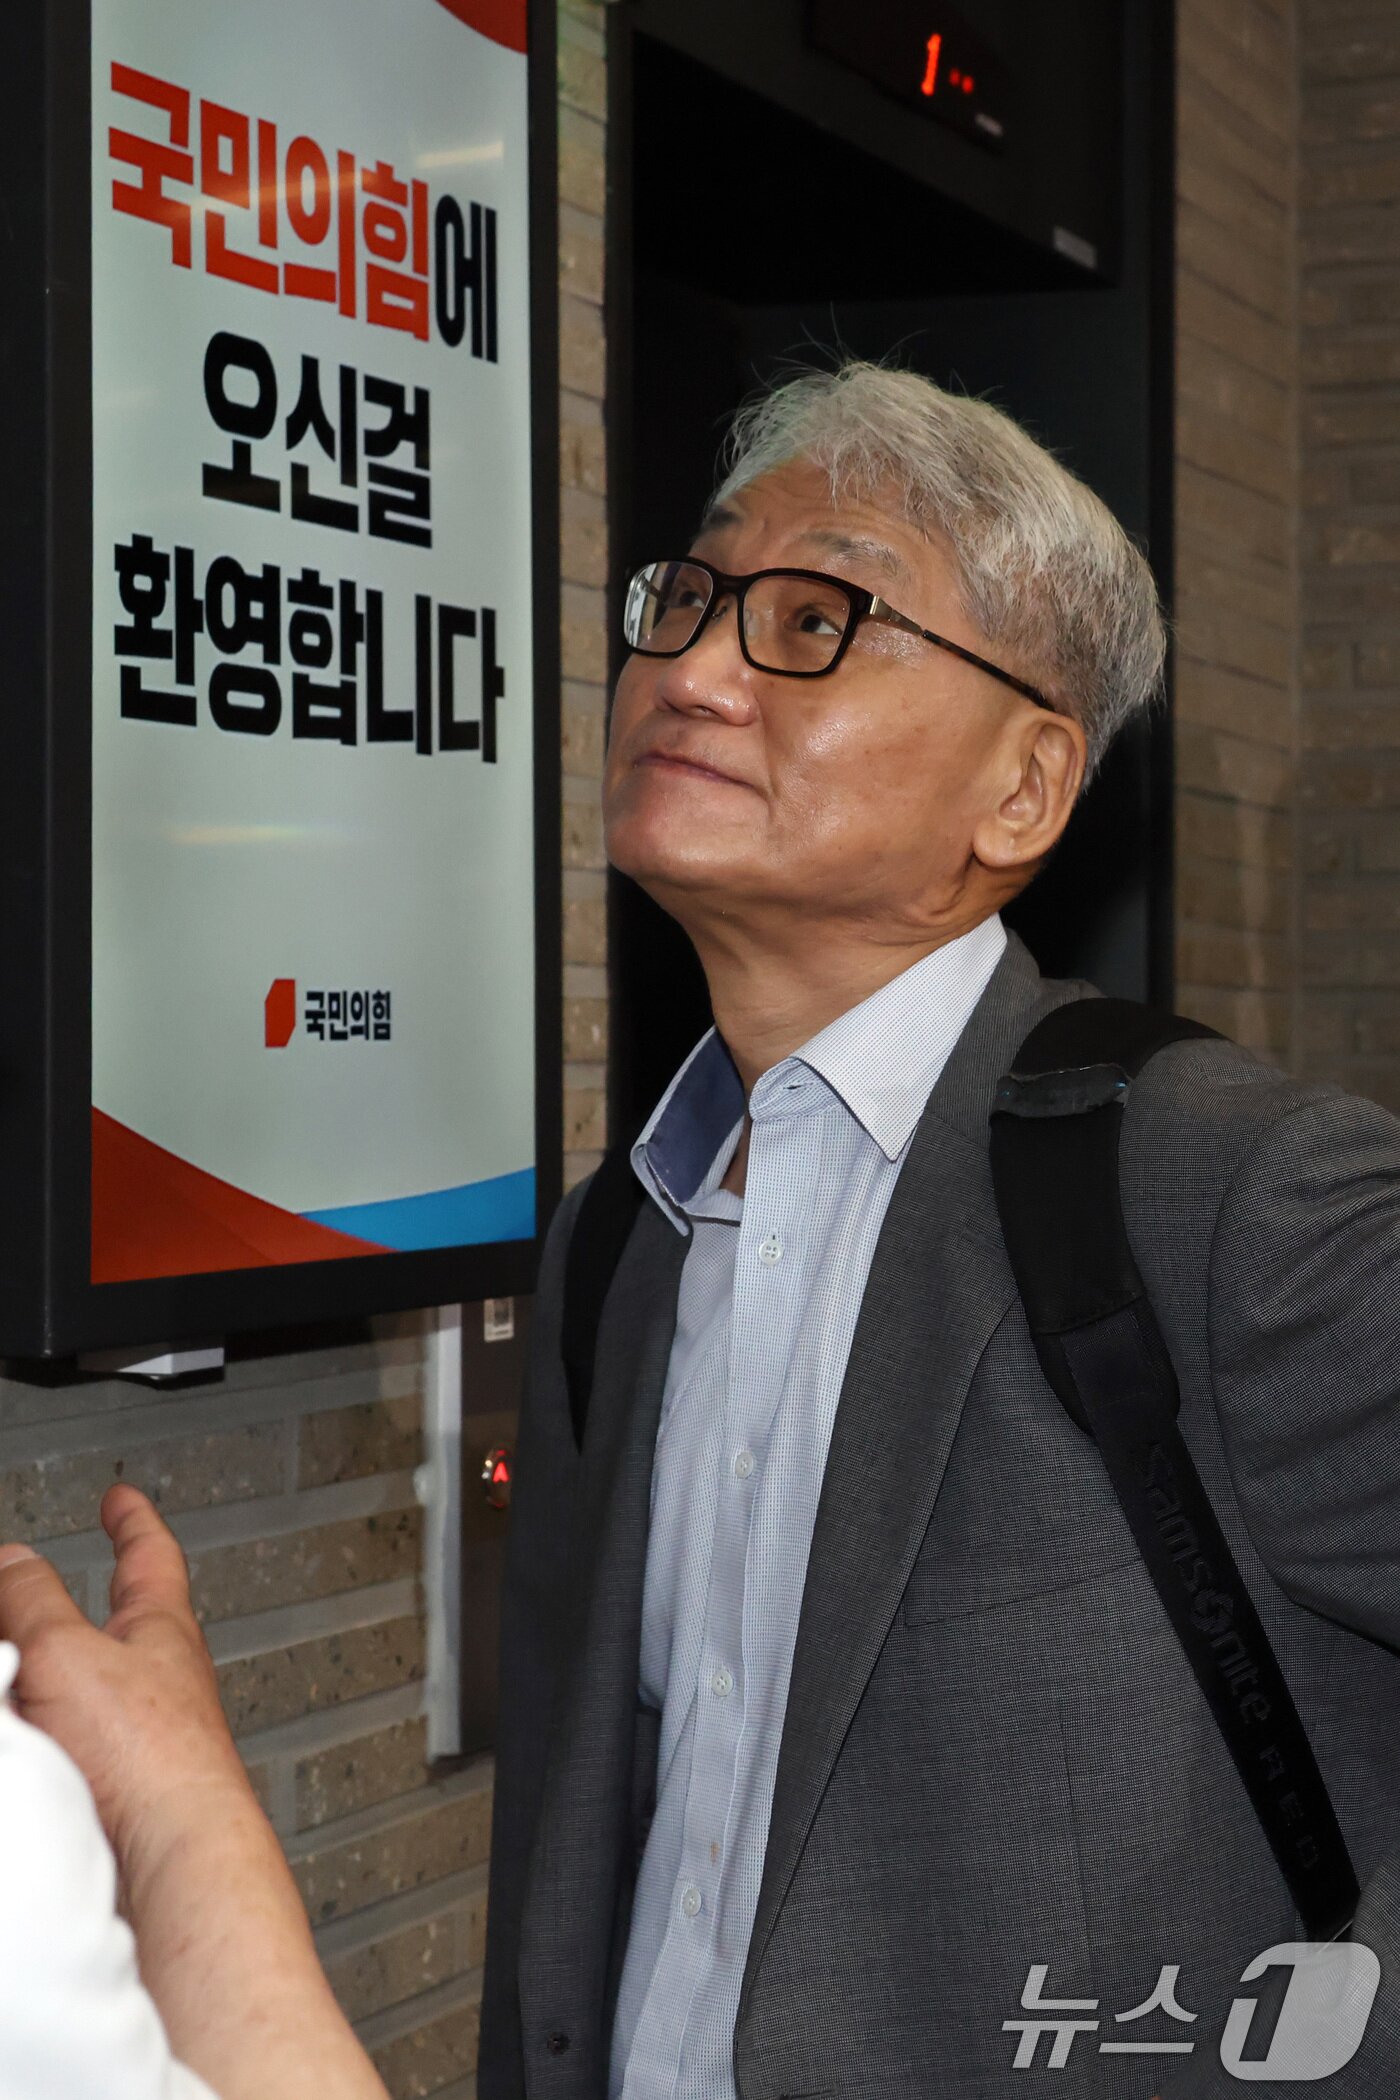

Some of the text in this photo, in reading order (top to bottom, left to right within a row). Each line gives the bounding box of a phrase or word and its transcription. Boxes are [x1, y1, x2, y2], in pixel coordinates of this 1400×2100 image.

[921, 33, 942, 96] 1
[107, 60, 498, 364] 국민의힘에
[202, 330, 433, 550] 오신걸
[113, 532, 505, 765] 환영합니다
[304, 989, 392, 1041] 국민의힘
